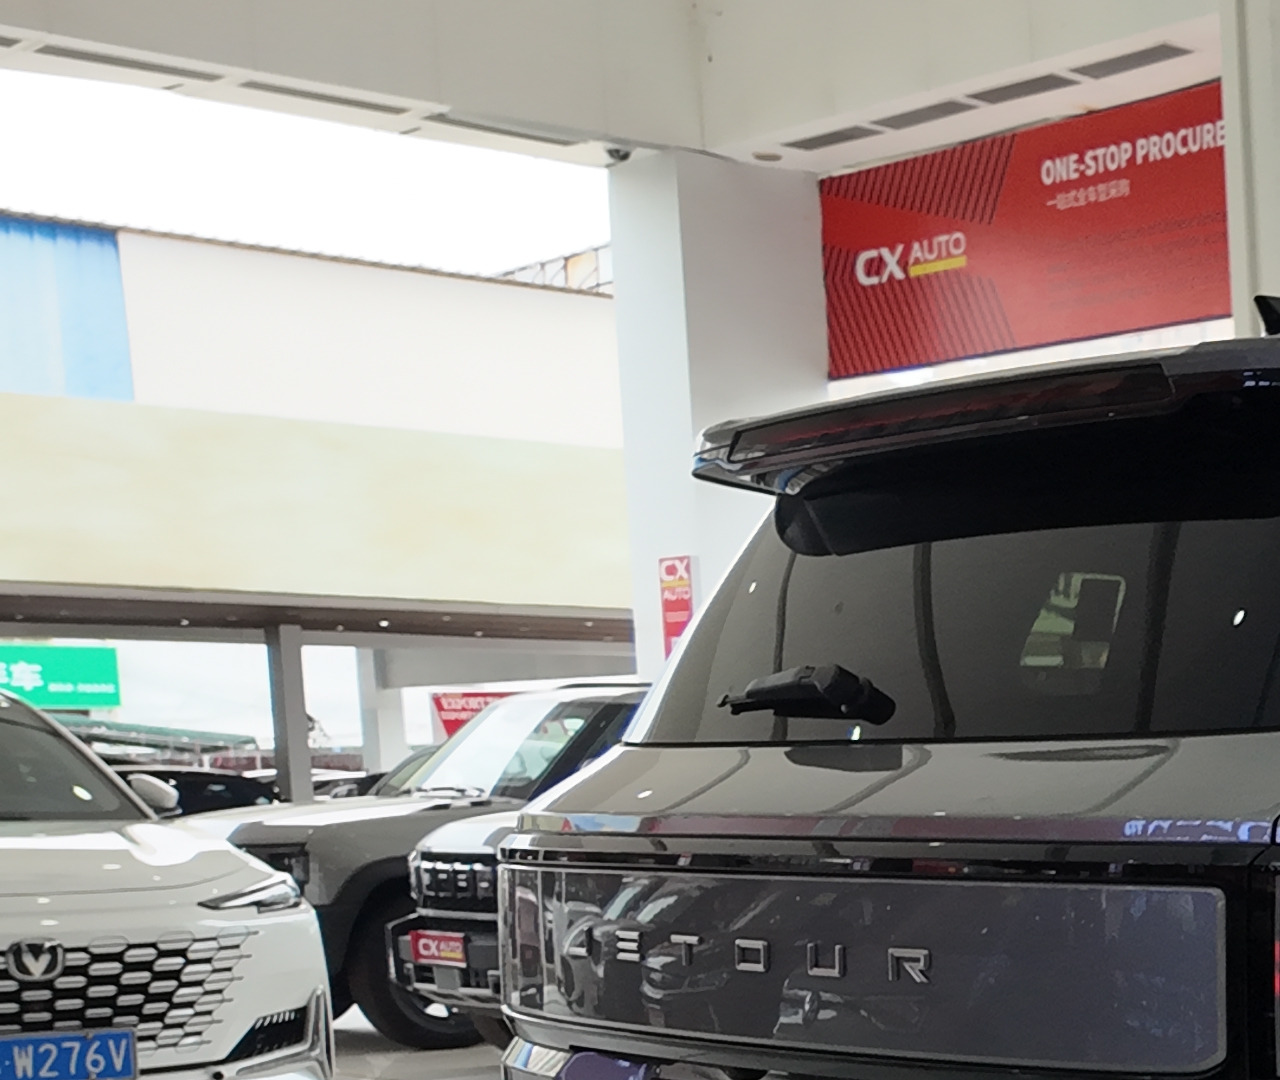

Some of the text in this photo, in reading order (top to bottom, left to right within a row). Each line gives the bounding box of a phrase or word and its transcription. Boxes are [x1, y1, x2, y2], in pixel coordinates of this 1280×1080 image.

[1041, 142, 1132, 186] ONE-STOP
[855, 231, 966, 286] CX AUTO
[660, 559, 688, 581] CX
[418, 938, 438, 956] CX
[563, 926, 931, 984] JETOUR
